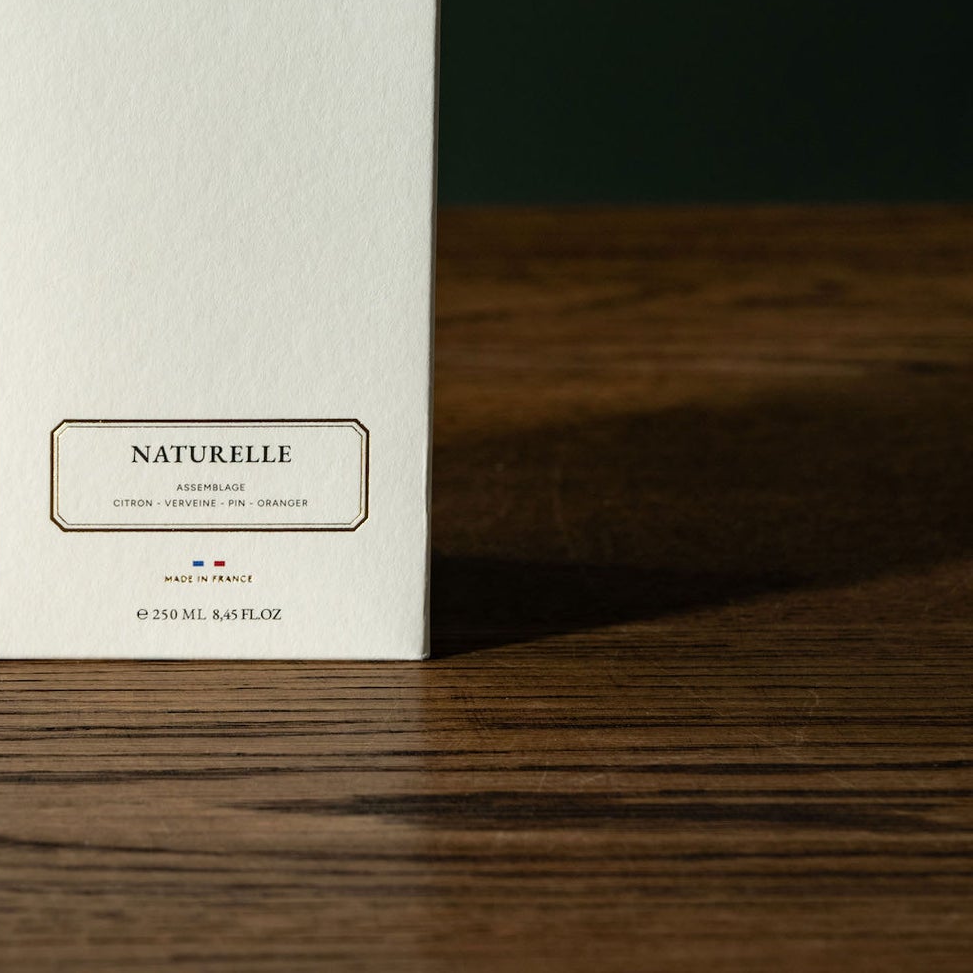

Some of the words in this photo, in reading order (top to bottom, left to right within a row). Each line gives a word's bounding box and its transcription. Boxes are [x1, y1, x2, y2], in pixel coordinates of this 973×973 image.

[131, 444, 292, 464] NATURELLE
[176, 483, 246, 492] ASSEMBLAGE
[113, 499, 153, 507] CITRON
[165, 499, 216, 507] VERVEINE
[228, 499, 246, 507] PIN
[257, 499, 308, 507] ORANGER
[164, 575, 193, 583] MADE
[197, 575, 208, 583] IN
[212, 575, 253, 583] FRANCE
[152, 608, 178, 620] 250
[182, 608, 207, 620] ML
[212, 608, 238, 622] 8,45
[241, 608, 282, 620] FL.OZ
